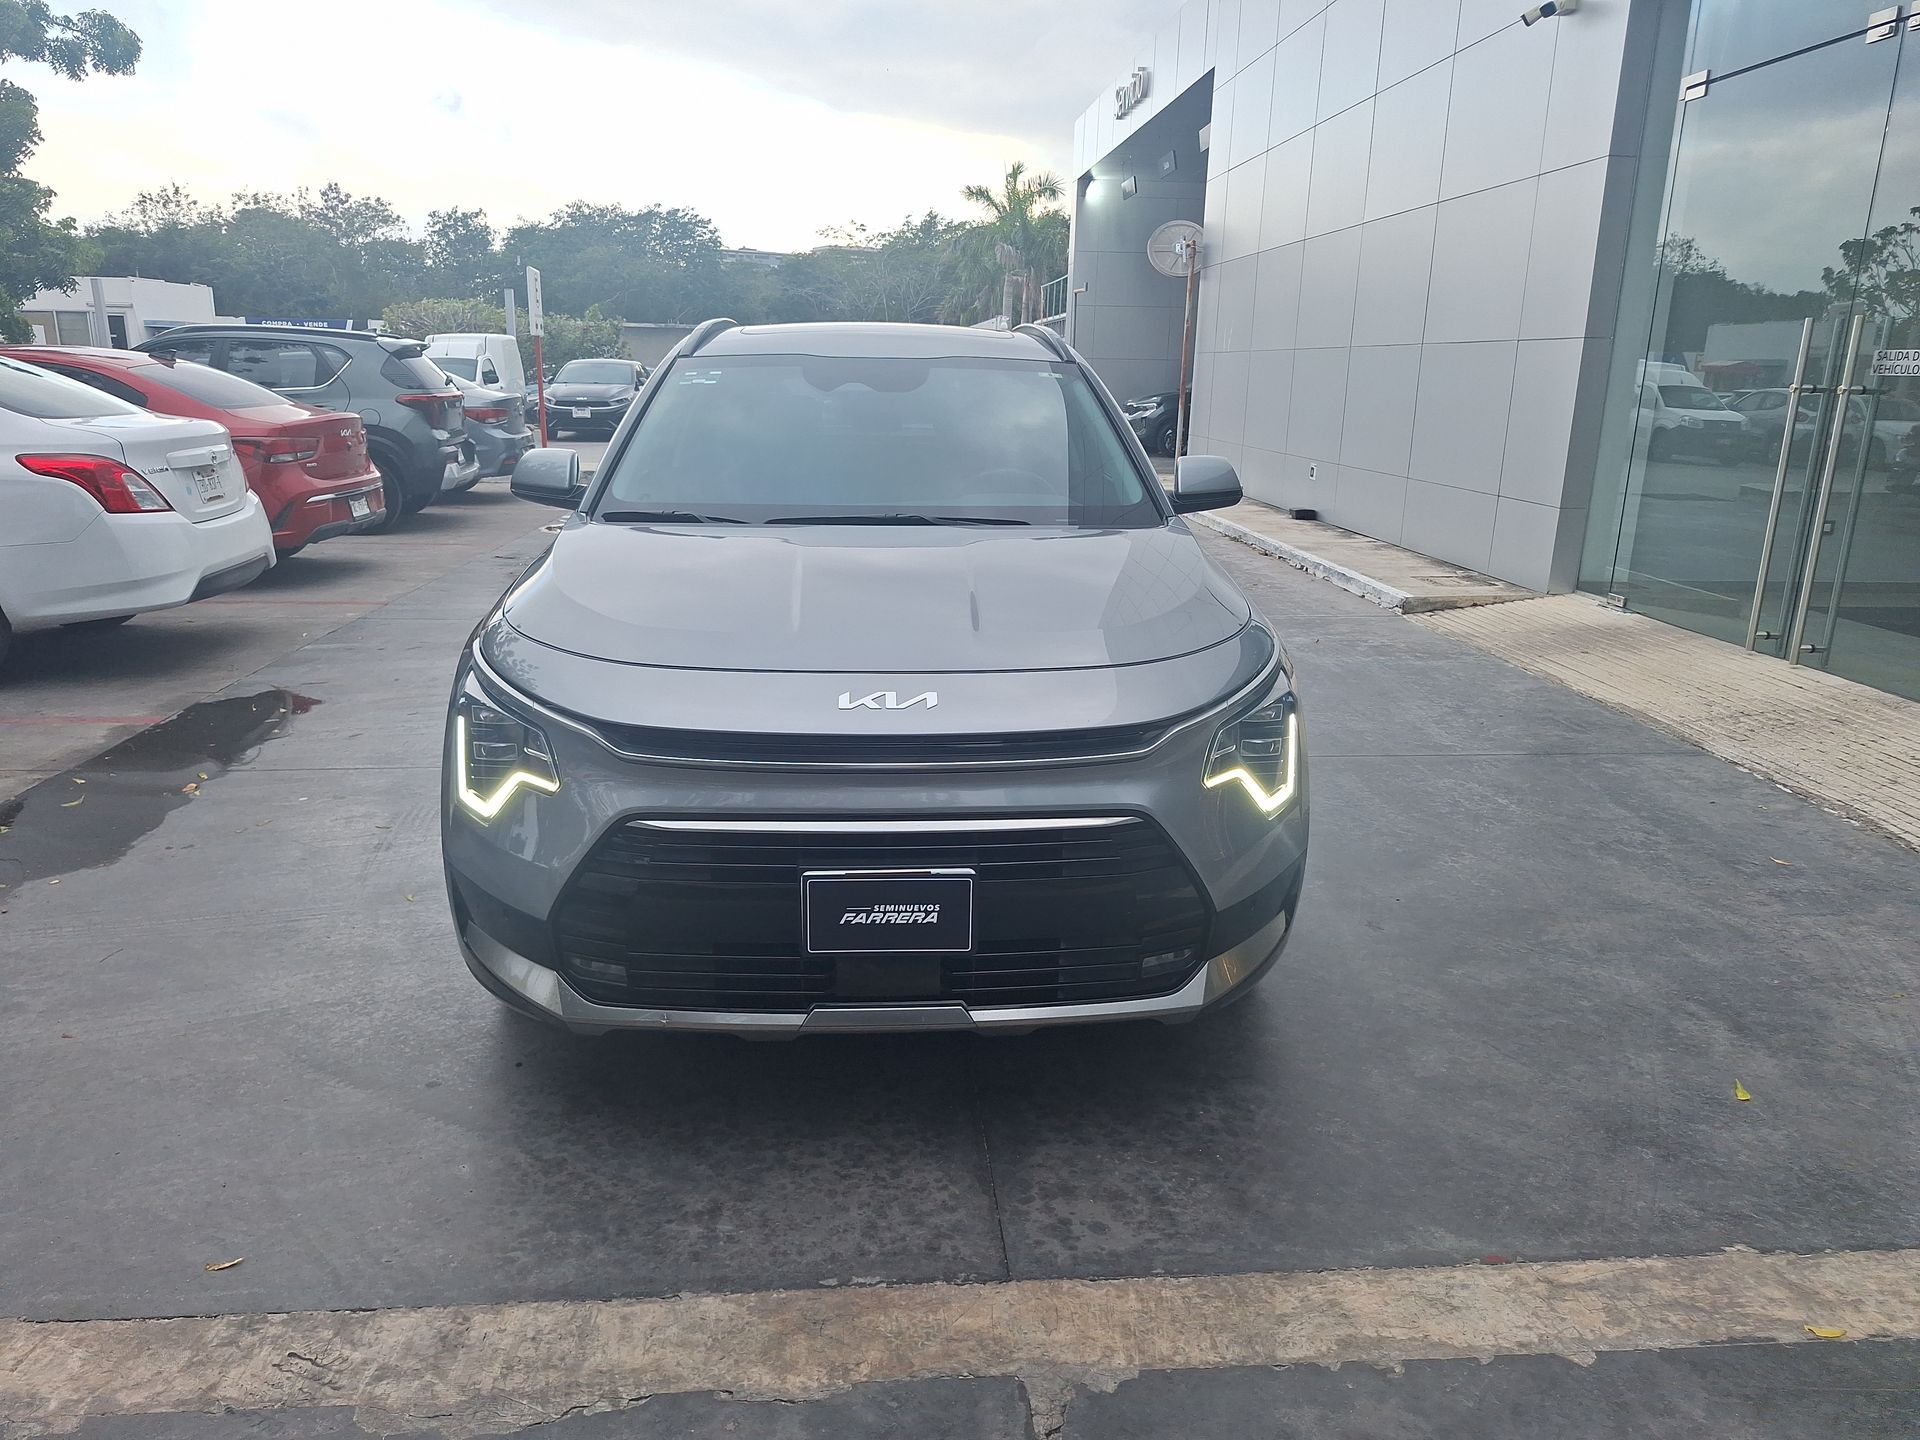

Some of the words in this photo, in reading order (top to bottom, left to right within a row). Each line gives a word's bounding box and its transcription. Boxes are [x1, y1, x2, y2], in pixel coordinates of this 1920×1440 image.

[1877, 351, 1910, 361] SALIDA
[1912, 351, 1920, 361] D
[1872, 362, 1920, 375] VEHÍCULO
[141, 466, 169, 475] VERSA
[839, 691, 938, 710] KIA
[873, 904, 940, 912] SEMINUEVOS
[839, 912, 938, 924] FARRERA
